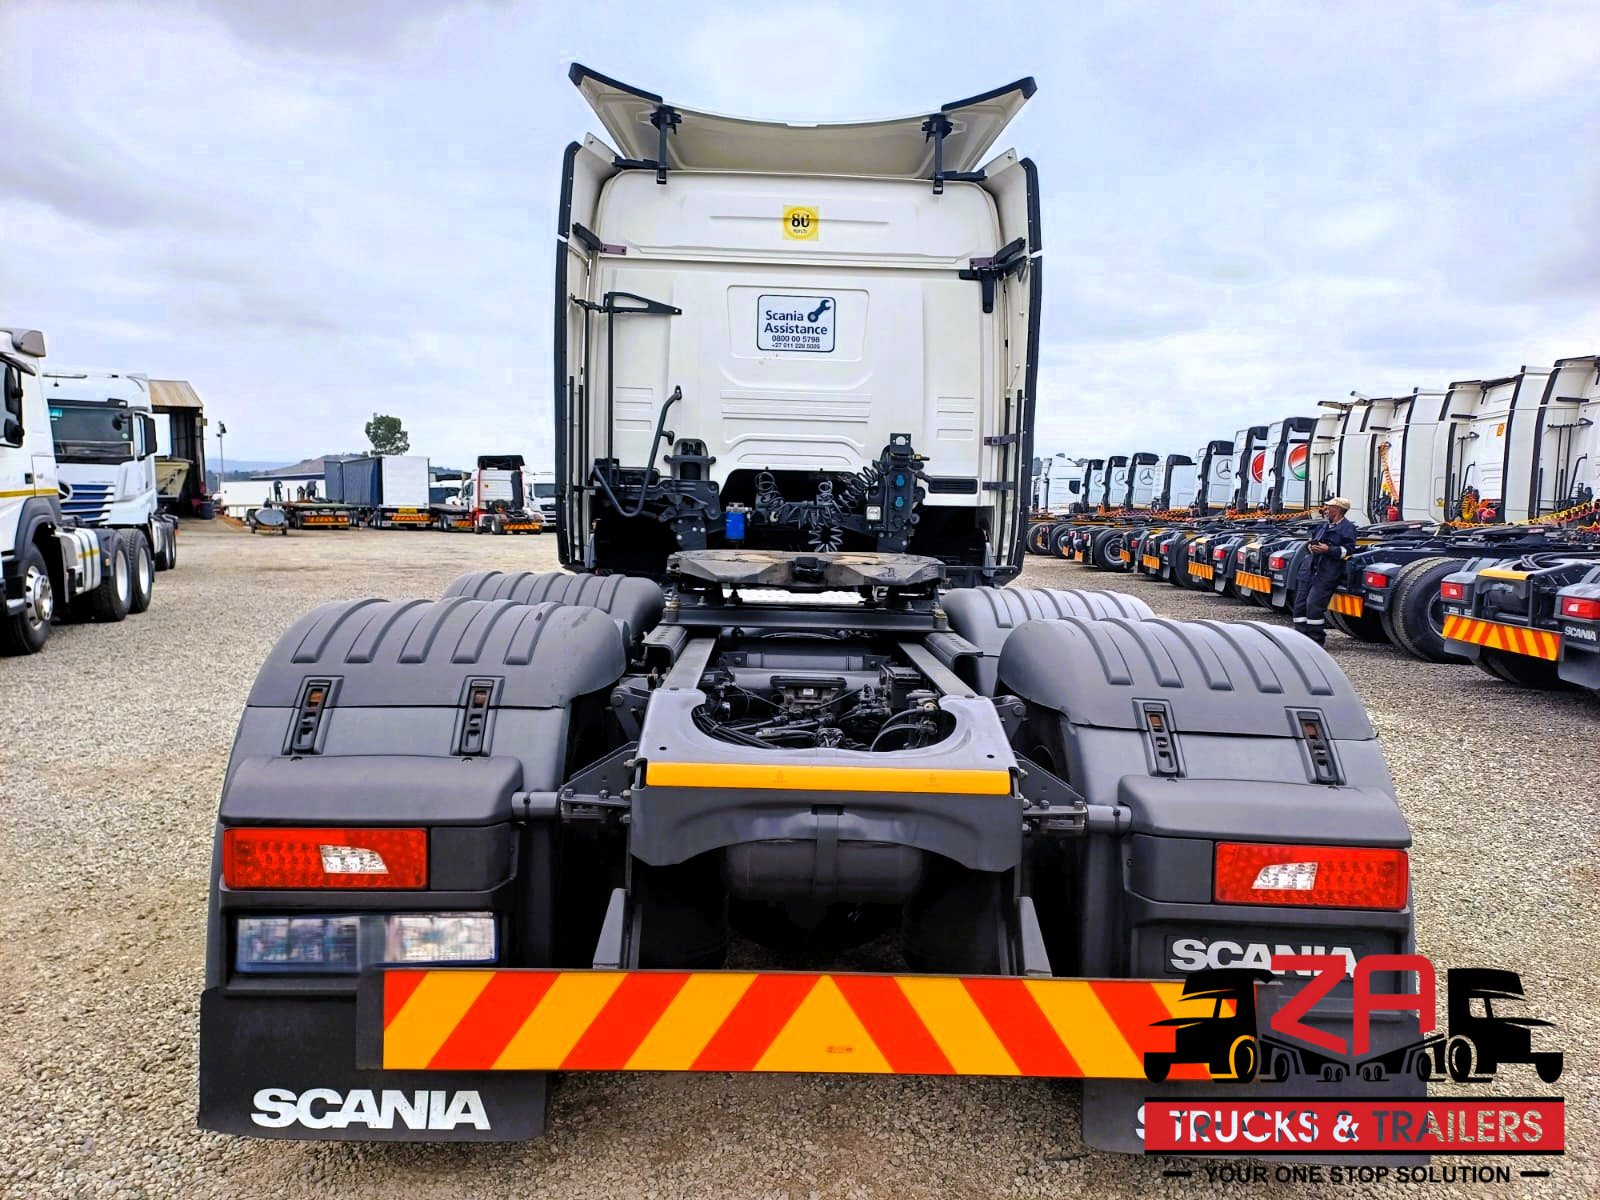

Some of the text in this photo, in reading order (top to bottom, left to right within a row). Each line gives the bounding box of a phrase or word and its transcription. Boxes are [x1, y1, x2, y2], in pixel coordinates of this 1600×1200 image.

[791, 213, 810, 228] 80
[765, 310, 804, 321] Scania
[764, 323, 828, 335] Assistance
[791, 335, 801, 343] 00
[1564, 625, 1597, 641] SCANIA
[250, 1088, 492, 1130] SCANIA
